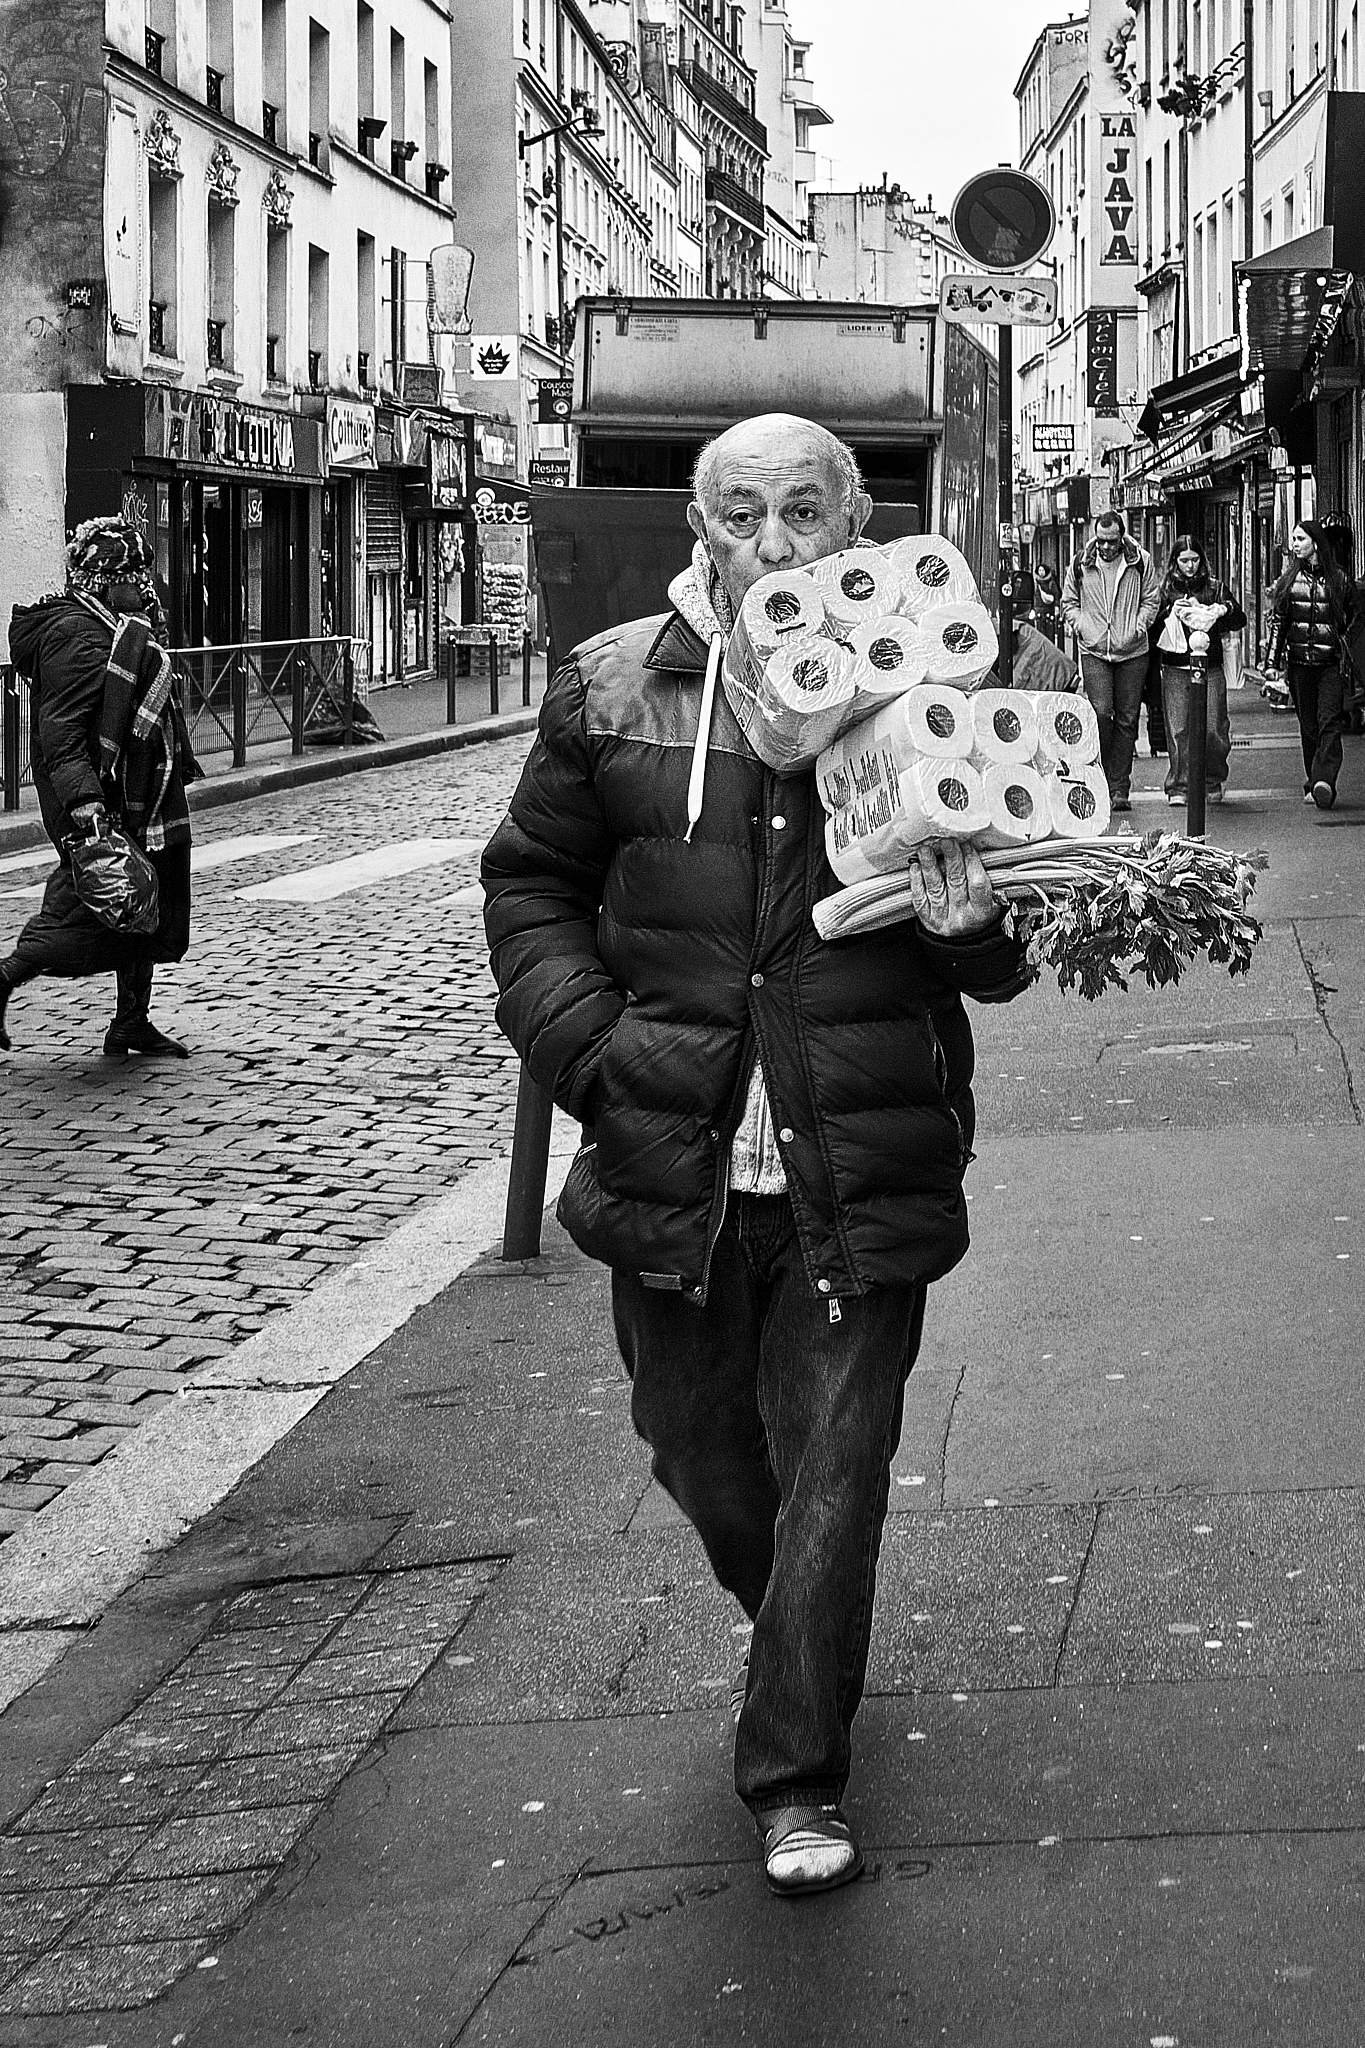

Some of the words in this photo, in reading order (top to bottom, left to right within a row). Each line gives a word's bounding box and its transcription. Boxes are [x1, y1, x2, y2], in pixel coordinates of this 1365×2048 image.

[1101, 117, 1136, 137] LA
[1104, 148, 1135, 260] JAVA
[331, 407, 368, 453] Coiffure
